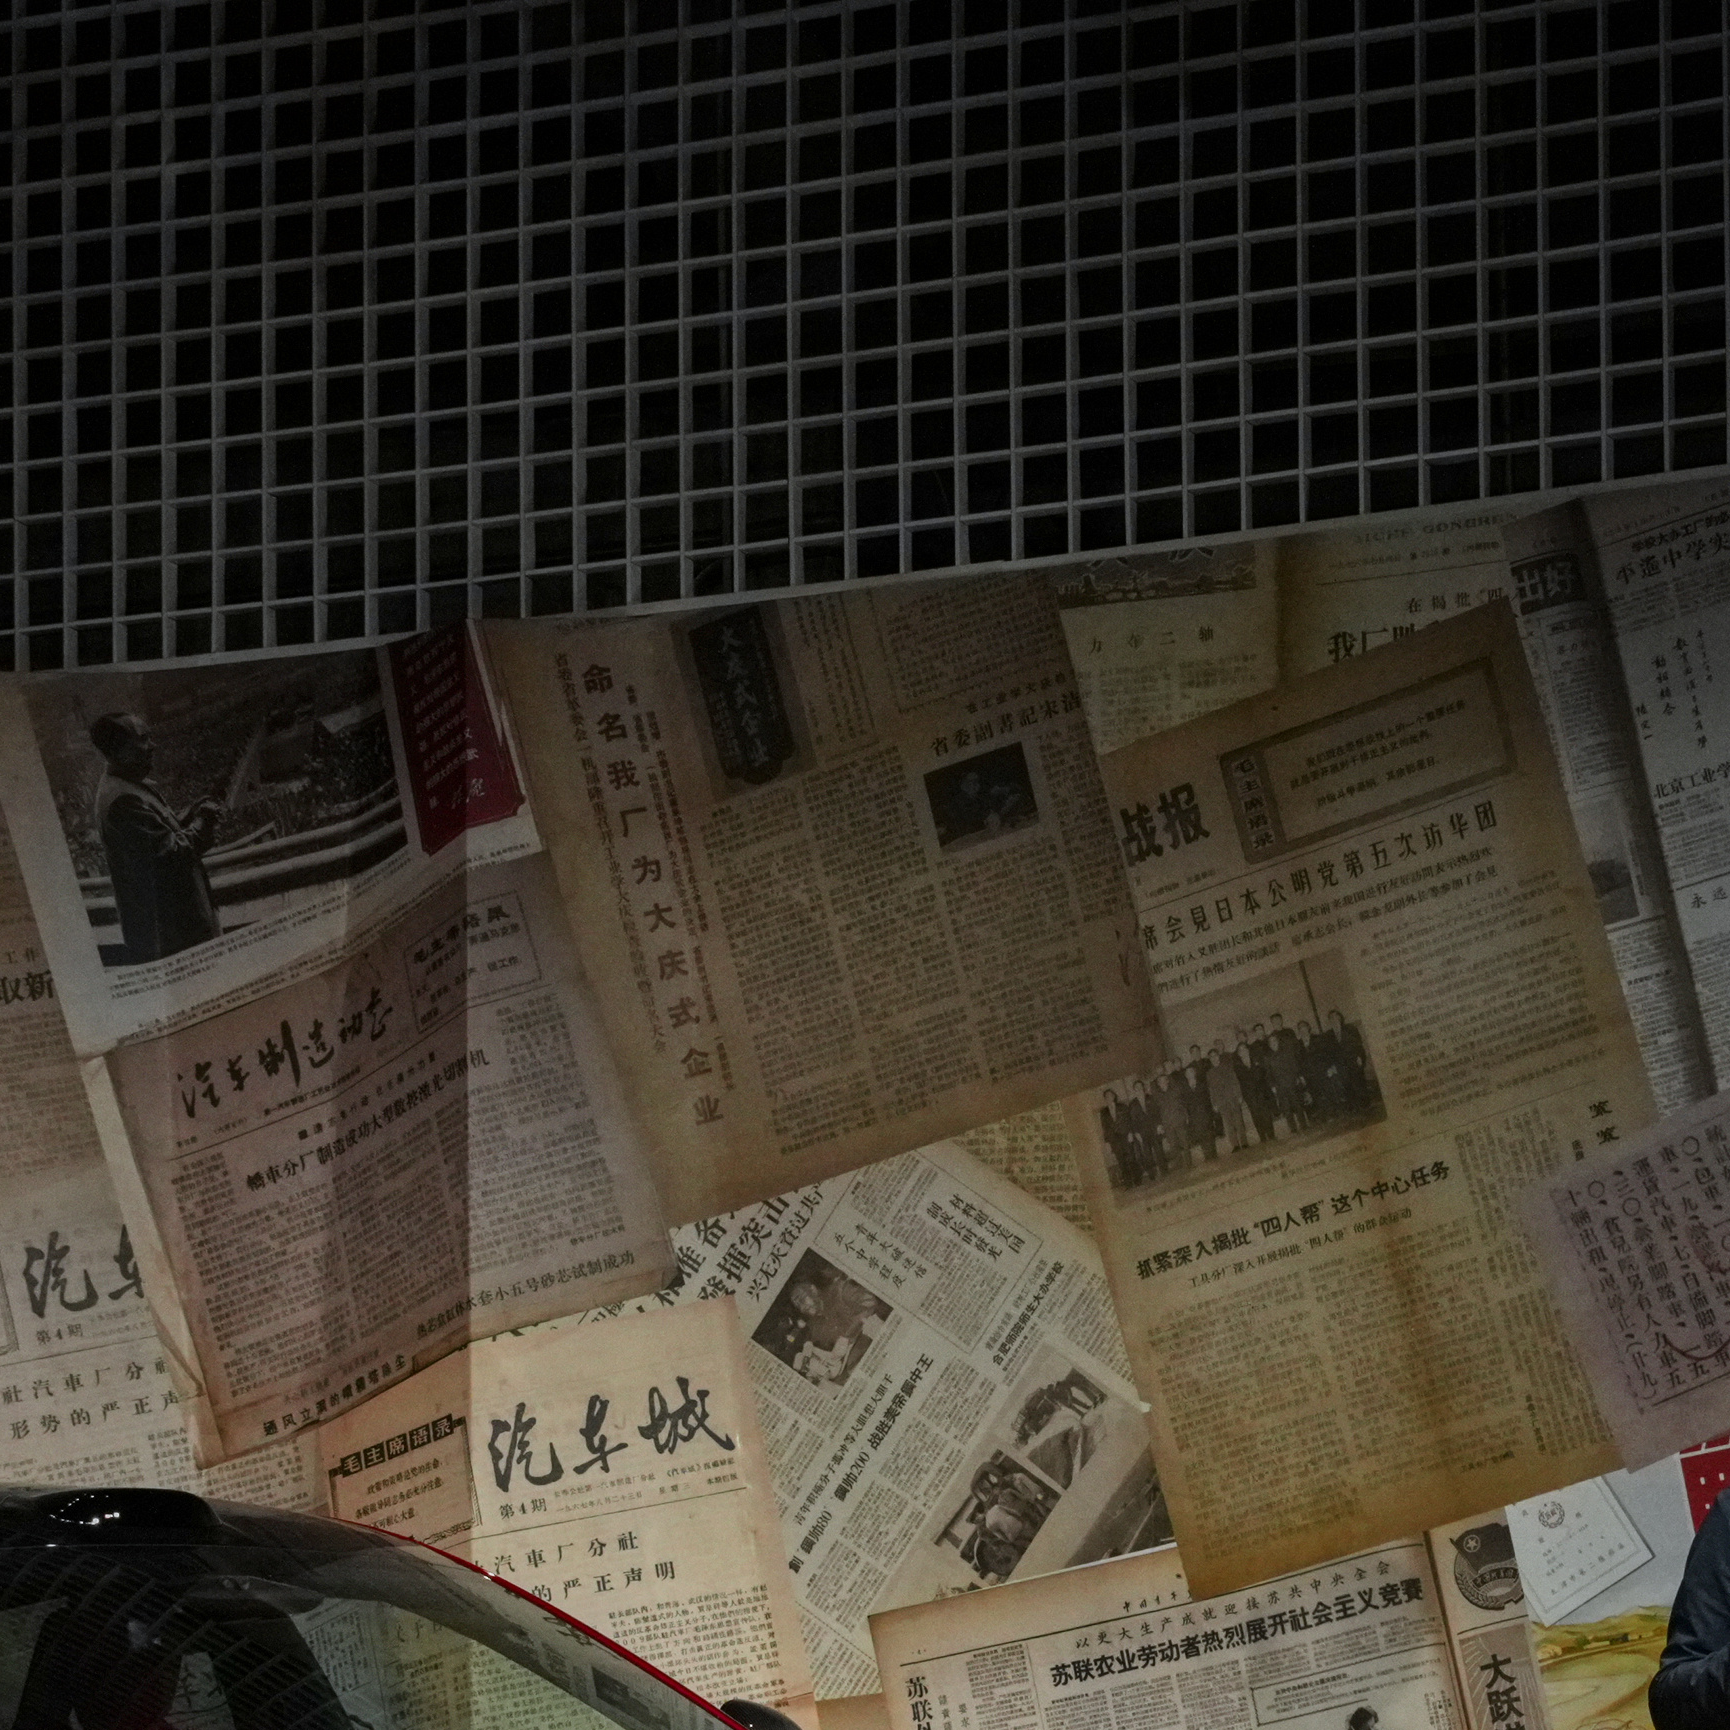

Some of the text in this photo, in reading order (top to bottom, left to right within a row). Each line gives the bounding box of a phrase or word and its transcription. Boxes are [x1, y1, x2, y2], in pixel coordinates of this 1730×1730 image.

[1120, 781, 1211, 867] 战报
[581, 661, 725, 1127] 命名我厂为大庆式企业
[1135, 1158, 1452, 1282] 抓紧深入揭批“四人帮”这个中心任务
[35, 1322, 85, 1346] 第4期
[340, 1413, 455, 1478] 毛主席语录
[487, 1374, 738, 1493] 汽车城
[498, 1496, 549, 1523] 第4期
[475, 1529, 640, 1577] 汽車厂分社
[1075, 1559, 1392, 1651] 以更大生产成就迎接苏共中央全会
